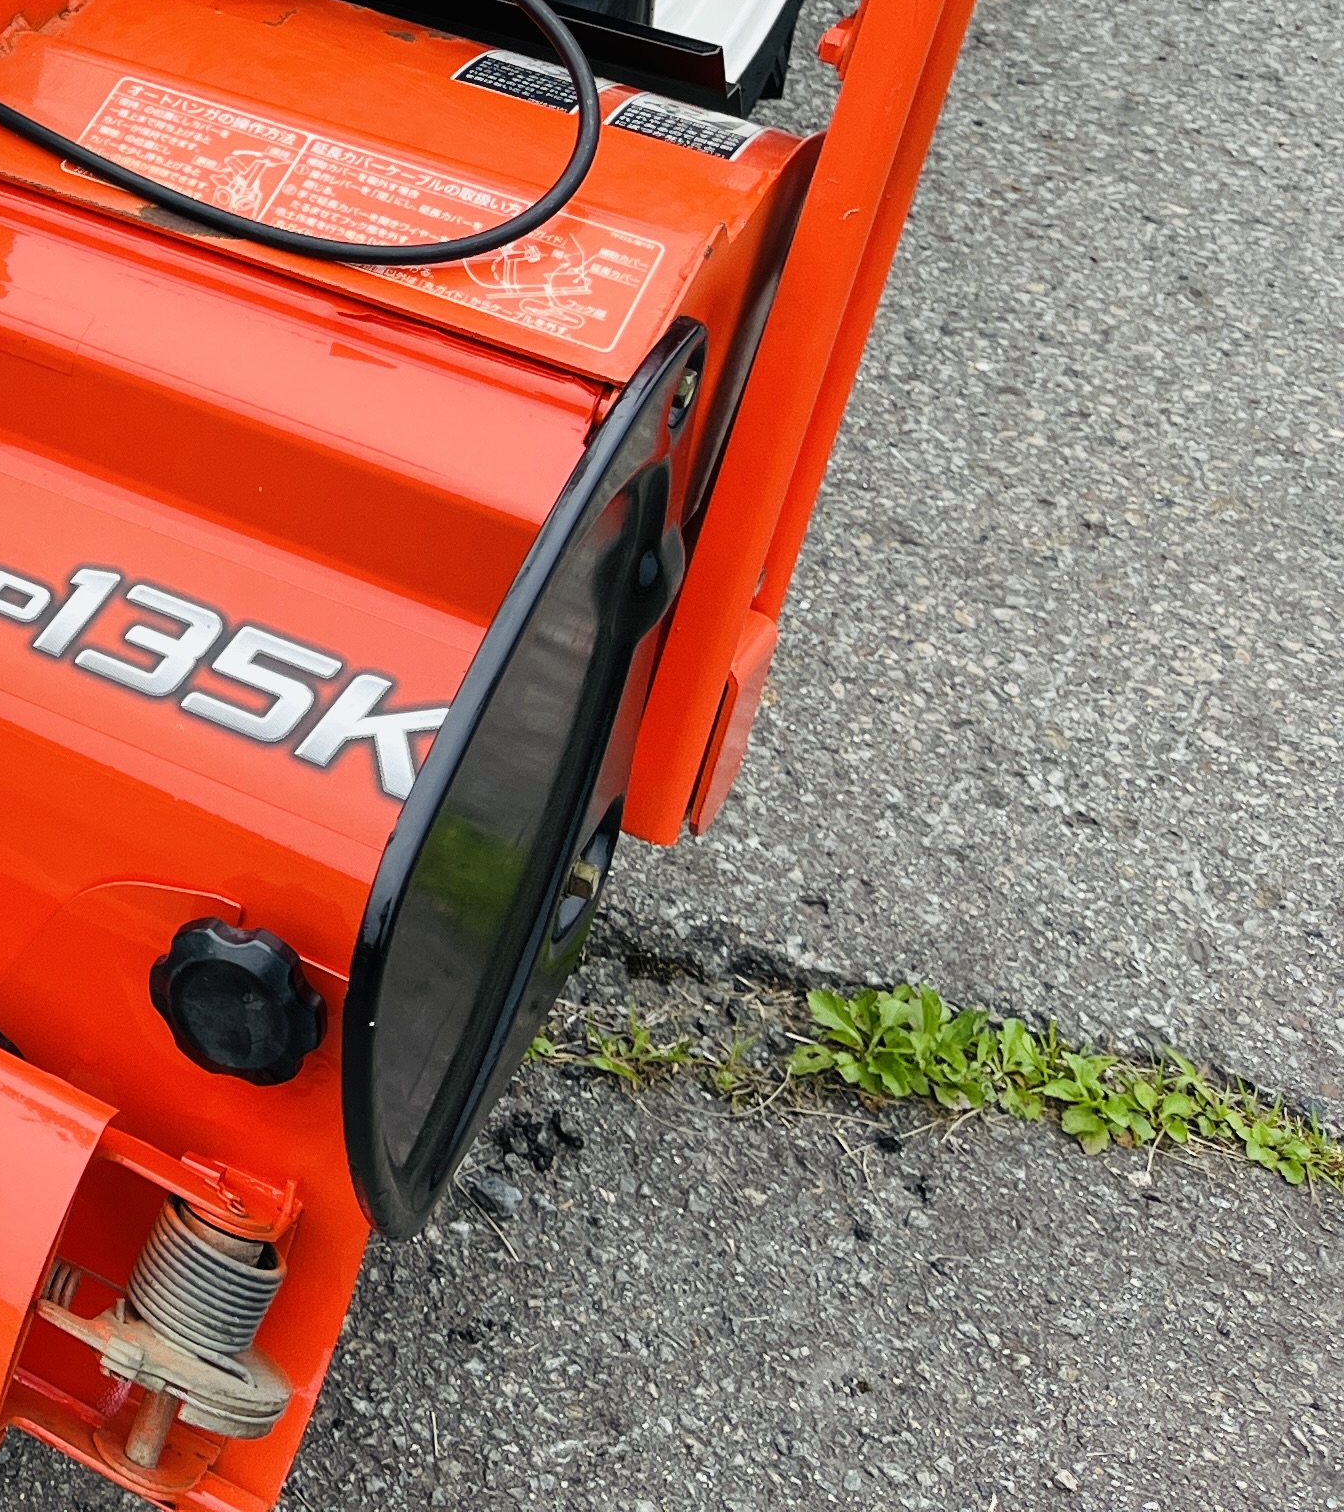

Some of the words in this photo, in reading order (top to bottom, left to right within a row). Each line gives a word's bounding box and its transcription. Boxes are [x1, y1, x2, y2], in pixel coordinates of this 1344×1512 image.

[125, 84, 298, 145] オートハンガの操作方法
